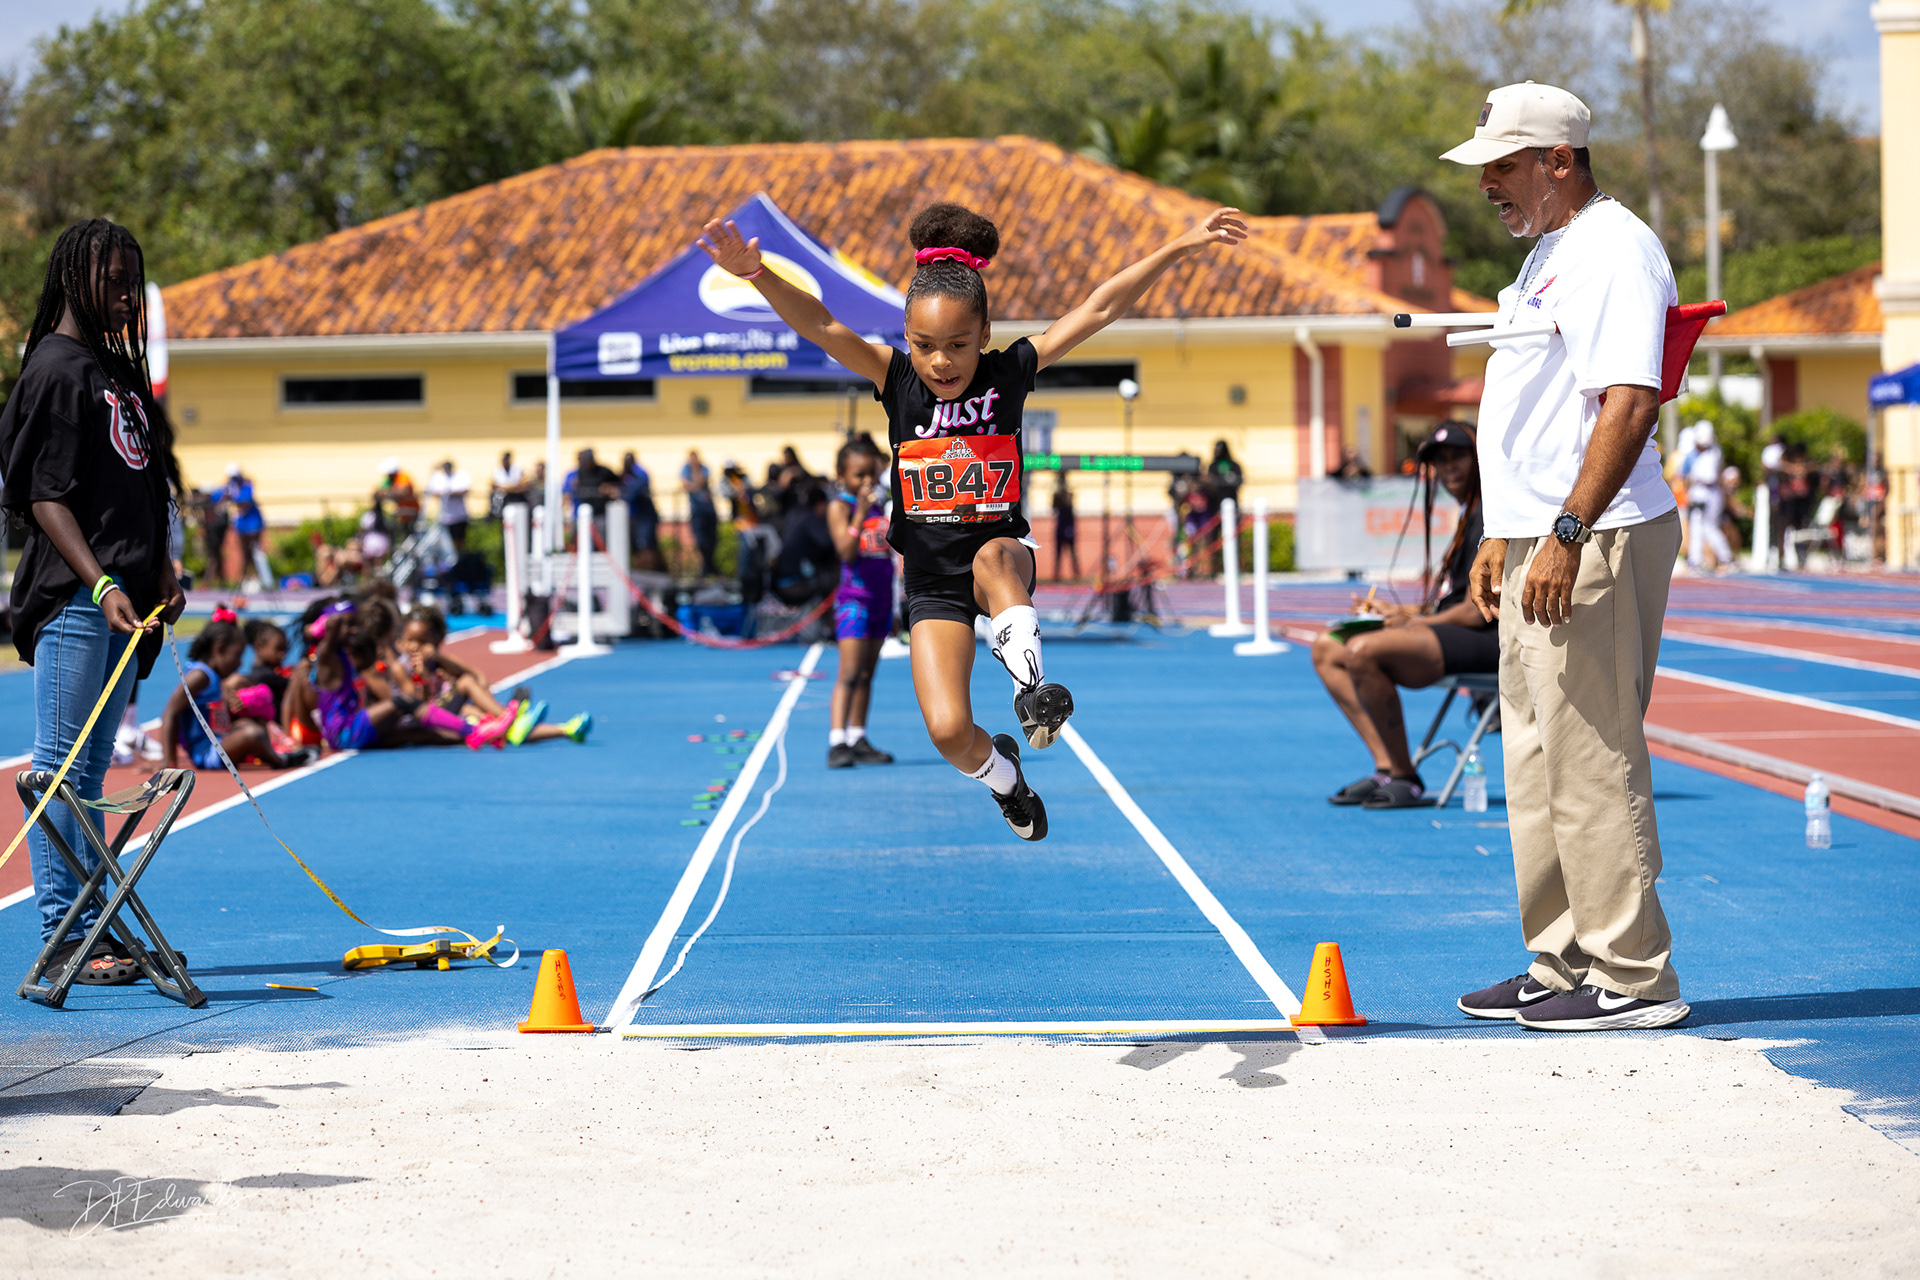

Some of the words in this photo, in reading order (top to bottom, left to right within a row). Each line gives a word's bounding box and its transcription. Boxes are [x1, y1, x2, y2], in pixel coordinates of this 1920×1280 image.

[659, 332, 703, 354] Live
[703, 328, 774, 351] Results
[775, 330, 799, 351] at
[915, 387, 1000, 438] just
[941, 452, 977, 460] CAPITAL
[902, 460, 1014, 501] 1847
[925, 515, 961, 524] SPEED
[961, 513, 1002, 523] CAPITAL
[554, 960, 566, 1000] HSHS
[1323, 957, 1331, 1000] HSHS
